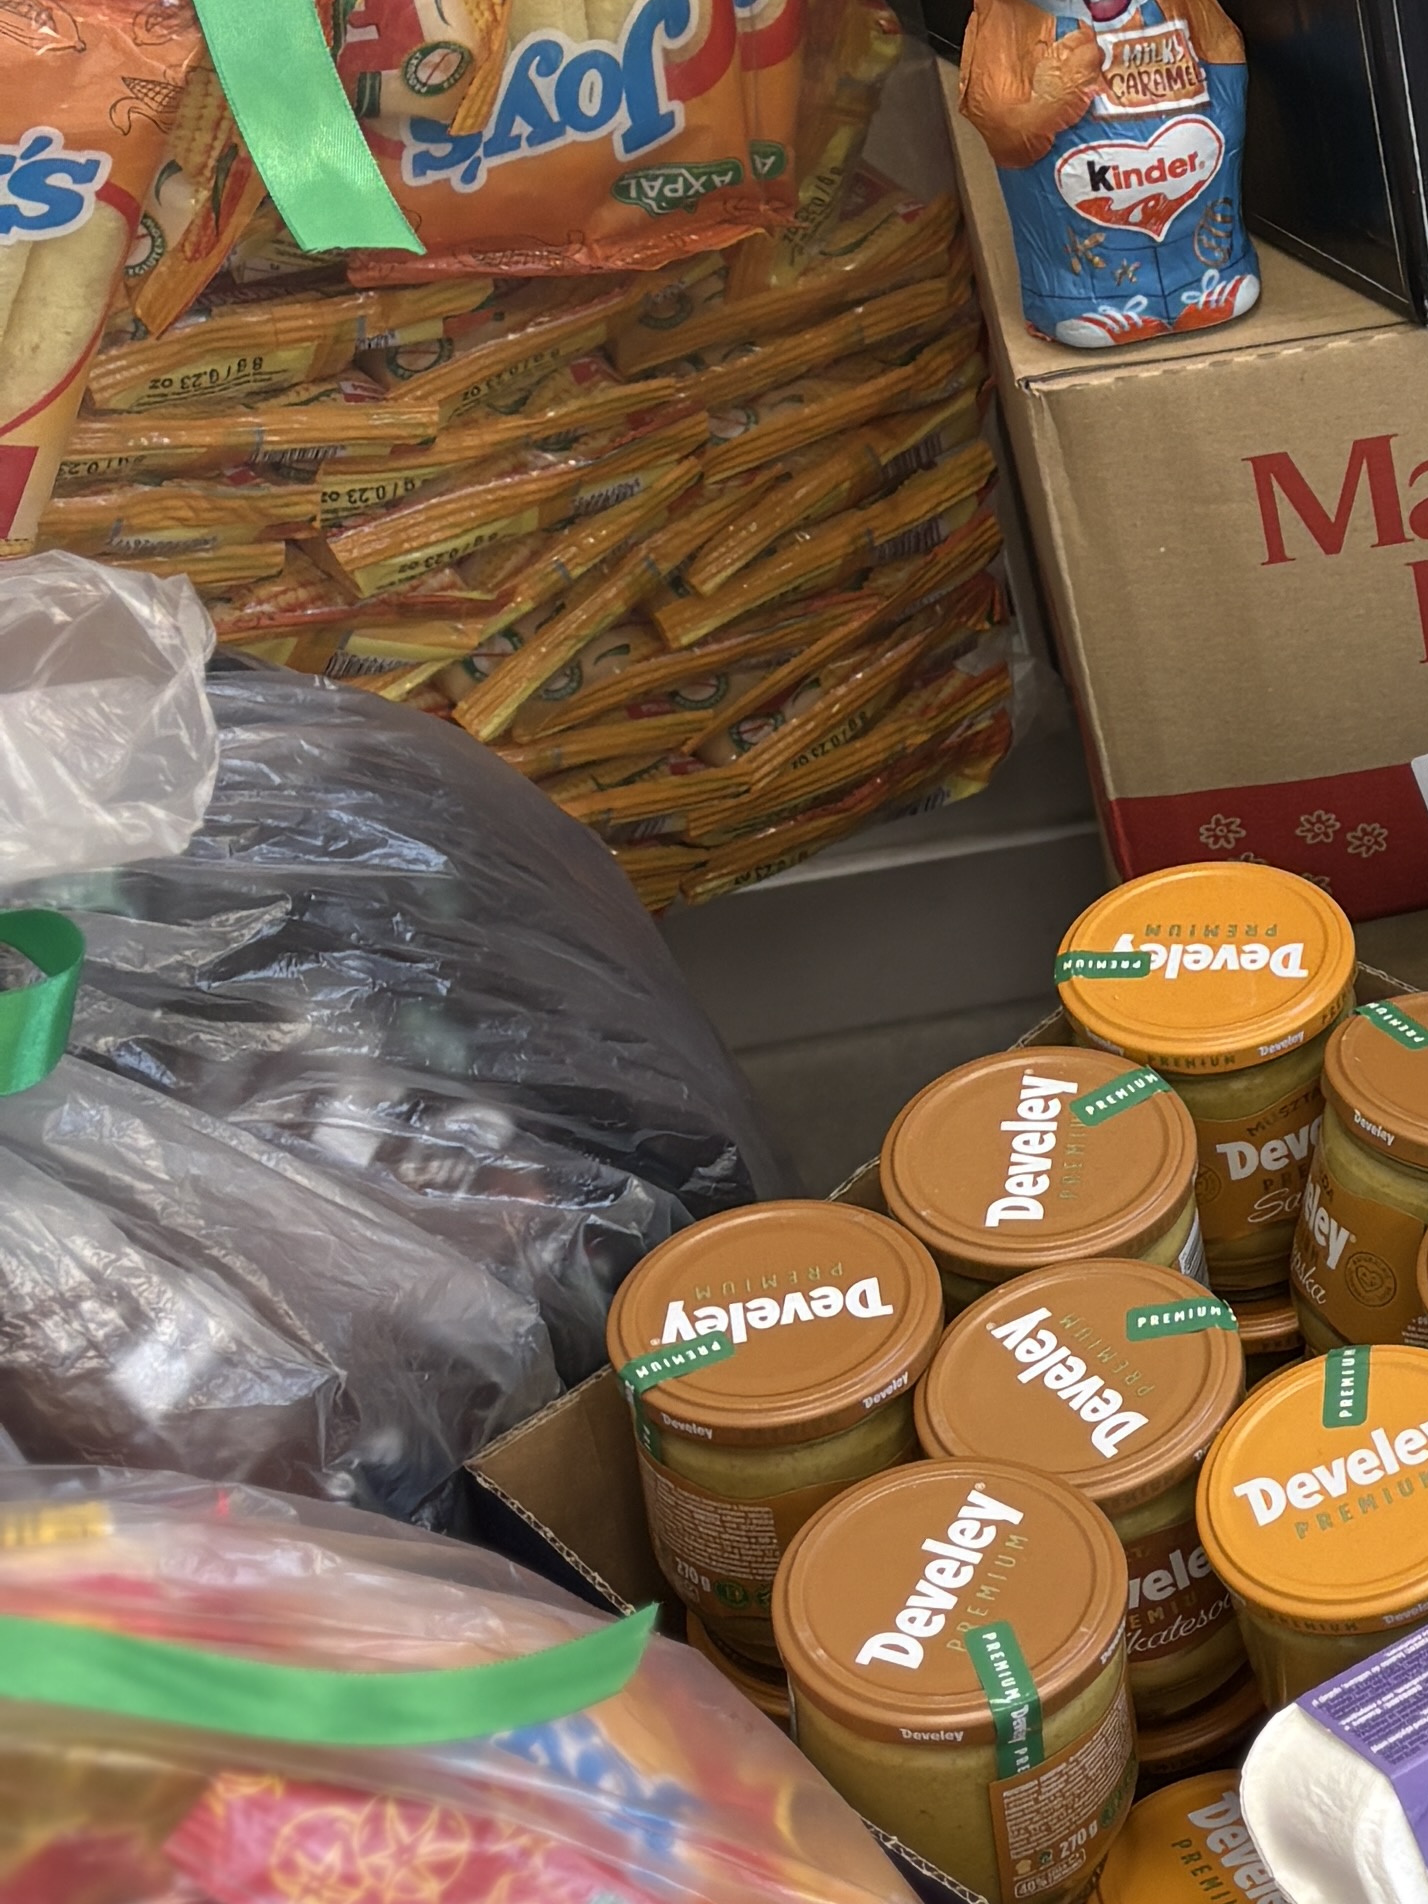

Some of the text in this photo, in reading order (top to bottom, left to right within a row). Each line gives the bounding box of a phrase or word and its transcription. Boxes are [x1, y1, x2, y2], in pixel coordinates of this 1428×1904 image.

[1109, 65, 1207, 98] CARAMEL
[1086, 152, 1199, 193] Kinder
[1063, 959, 1142, 971] PREMIUM
[1367, 1001, 1425, 1044] PREMIUM
[1084, 1072, 1158, 1116] PREMIUM
[986, 1074, 1078, 1227] Develey
[661, 1277, 893, 1344] Develey
[1137, 1307, 1220, 1328] PREMIUM
[636, 1340, 721, 1378] PREMIUM
[998, 1307, 1149, 1458] Develey
[1339, 1347, 1356, 1417] PREMIUM
[855, 1487, 1024, 1669] Develey
[982, 1632, 1018, 1706] PREMIUM
[901, 1728, 964, 1743] Develey
